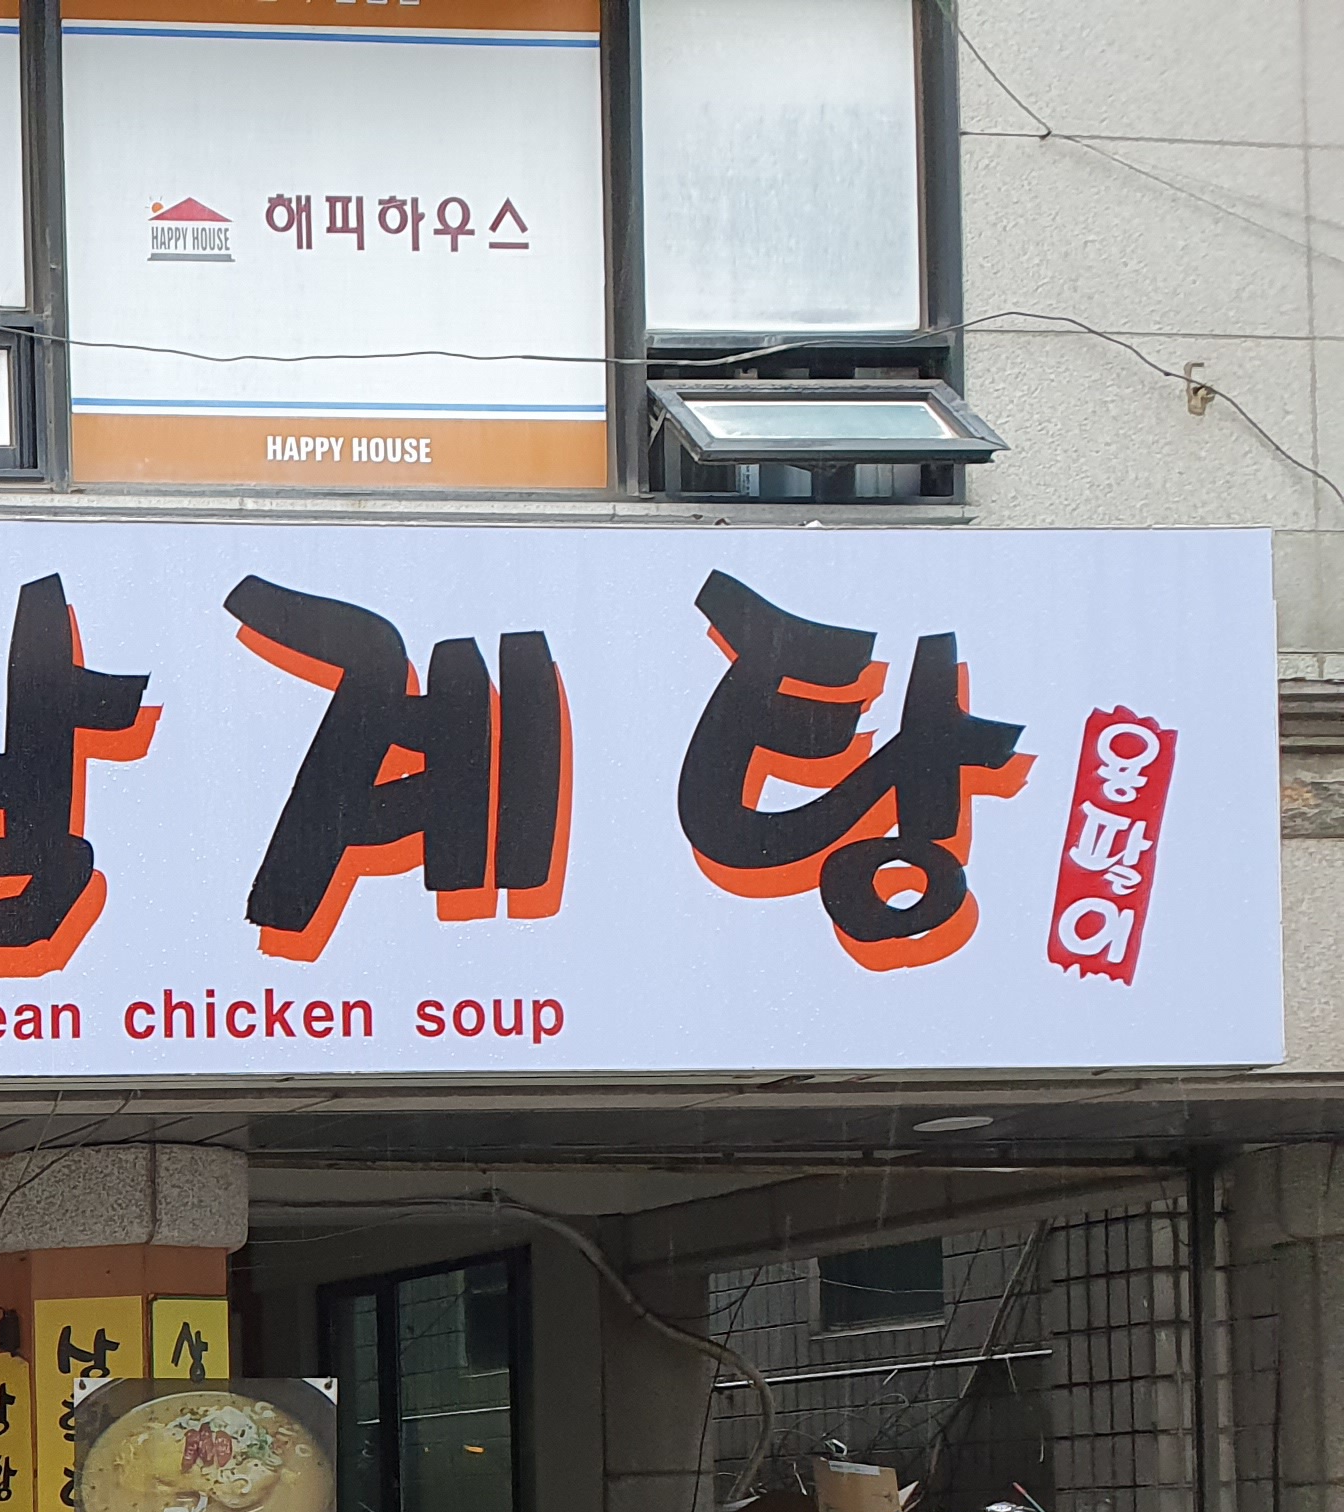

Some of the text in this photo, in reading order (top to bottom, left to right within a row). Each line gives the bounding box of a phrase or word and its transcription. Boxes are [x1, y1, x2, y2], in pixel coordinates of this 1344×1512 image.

[151, 226, 231, 253] HAPPY HOUSE
[265, 193, 530, 253] 해피하우스
[266, 434, 432, 464] HAPPY HOUSE
[123, 988, 375, 1040] chicken
[415, 996, 566, 1045] soup
